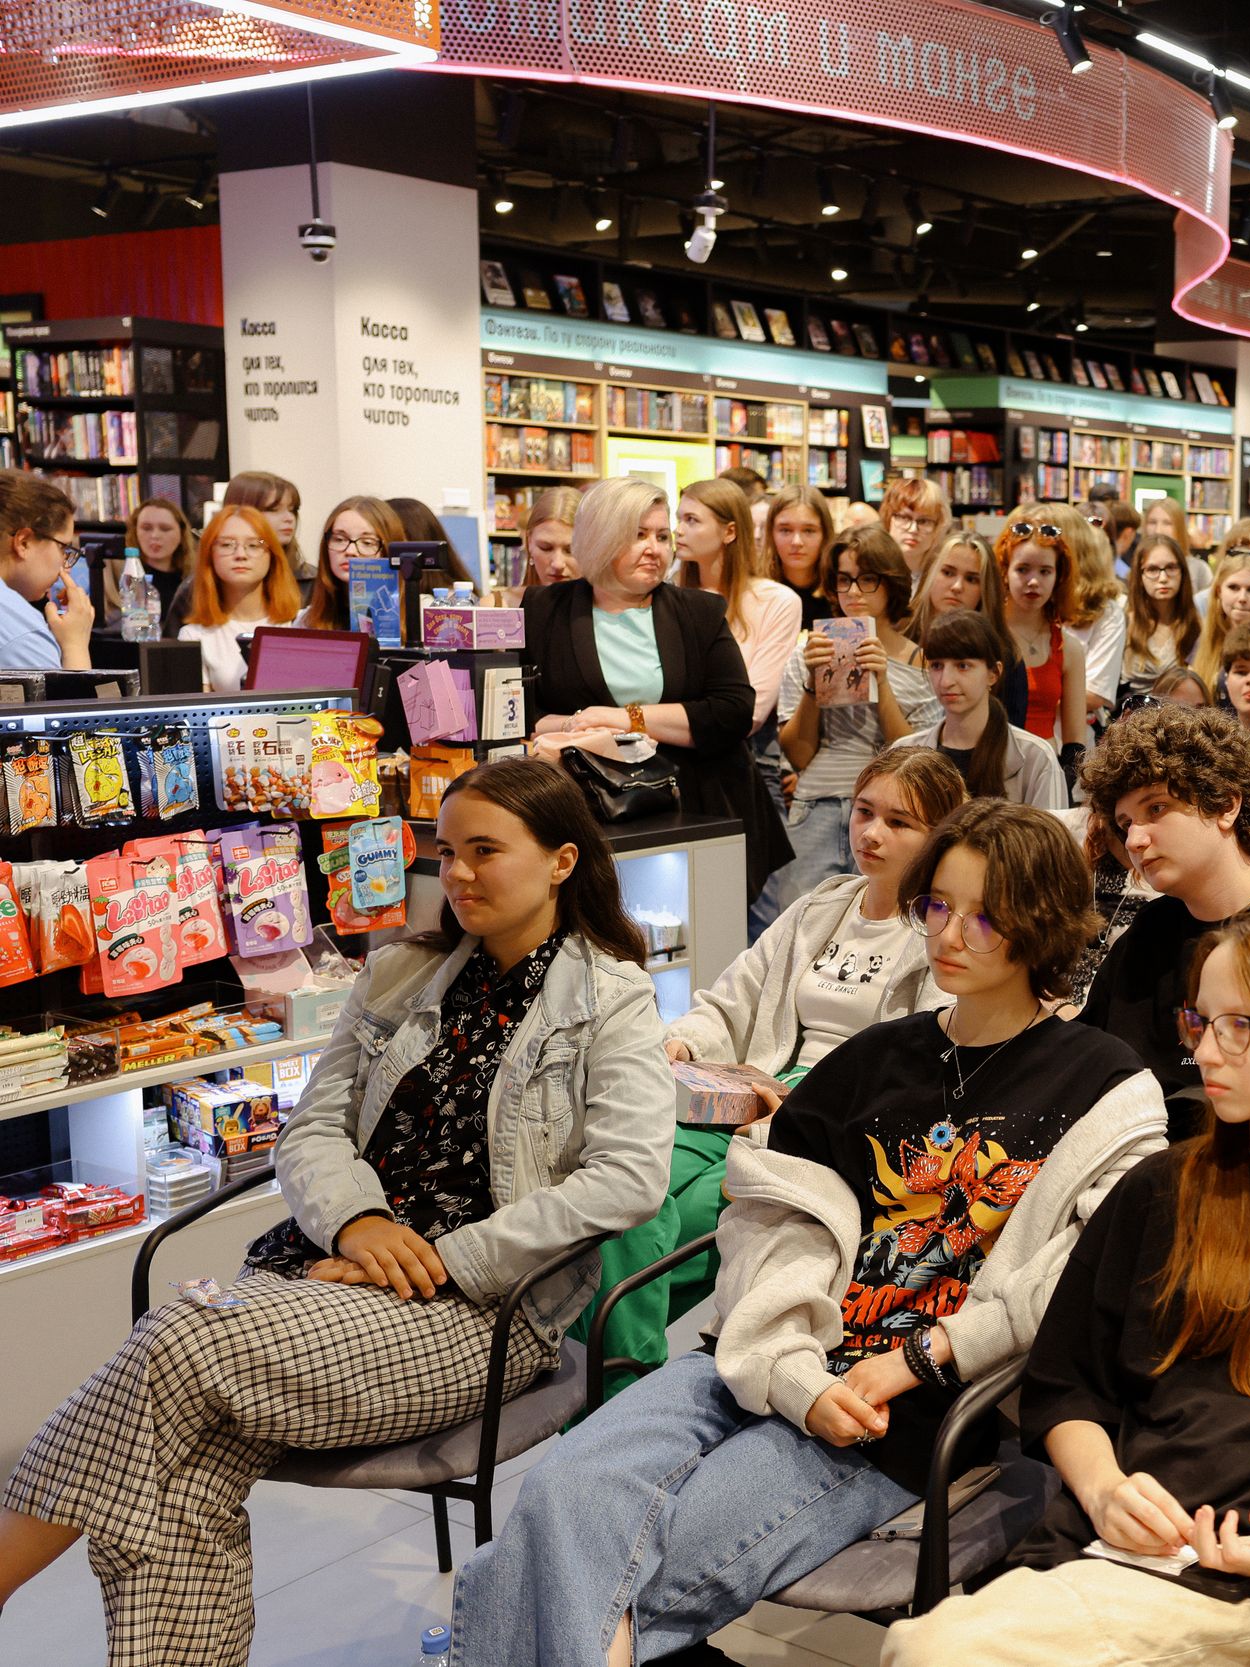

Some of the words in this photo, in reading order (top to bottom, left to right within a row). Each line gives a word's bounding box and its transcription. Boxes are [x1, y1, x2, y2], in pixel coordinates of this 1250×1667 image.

[877, 30, 1037, 121] манге
[241, 318, 276, 337] Касса
[360, 317, 408, 341] Касса
[242, 355, 261, 376] для
[265, 356, 284, 373] тех,
[363, 356, 387, 376] для
[392, 358, 418, 379] тех,
[244, 382, 259, 396] кто
[263, 380, 318, 402] торопится
[363, 383, 385, 398] кто
[391, 384, 460, 406] торопится
[244, 407, 279, 423] читать
[364, 407, 410, 427] читать
[358, 849, 398, 866] GUMMY
[123, 1054, 176, 1072] MELLER
[279, 1067, 300, 1080] BOX
[229, 1143, 246, 1153] BOX
